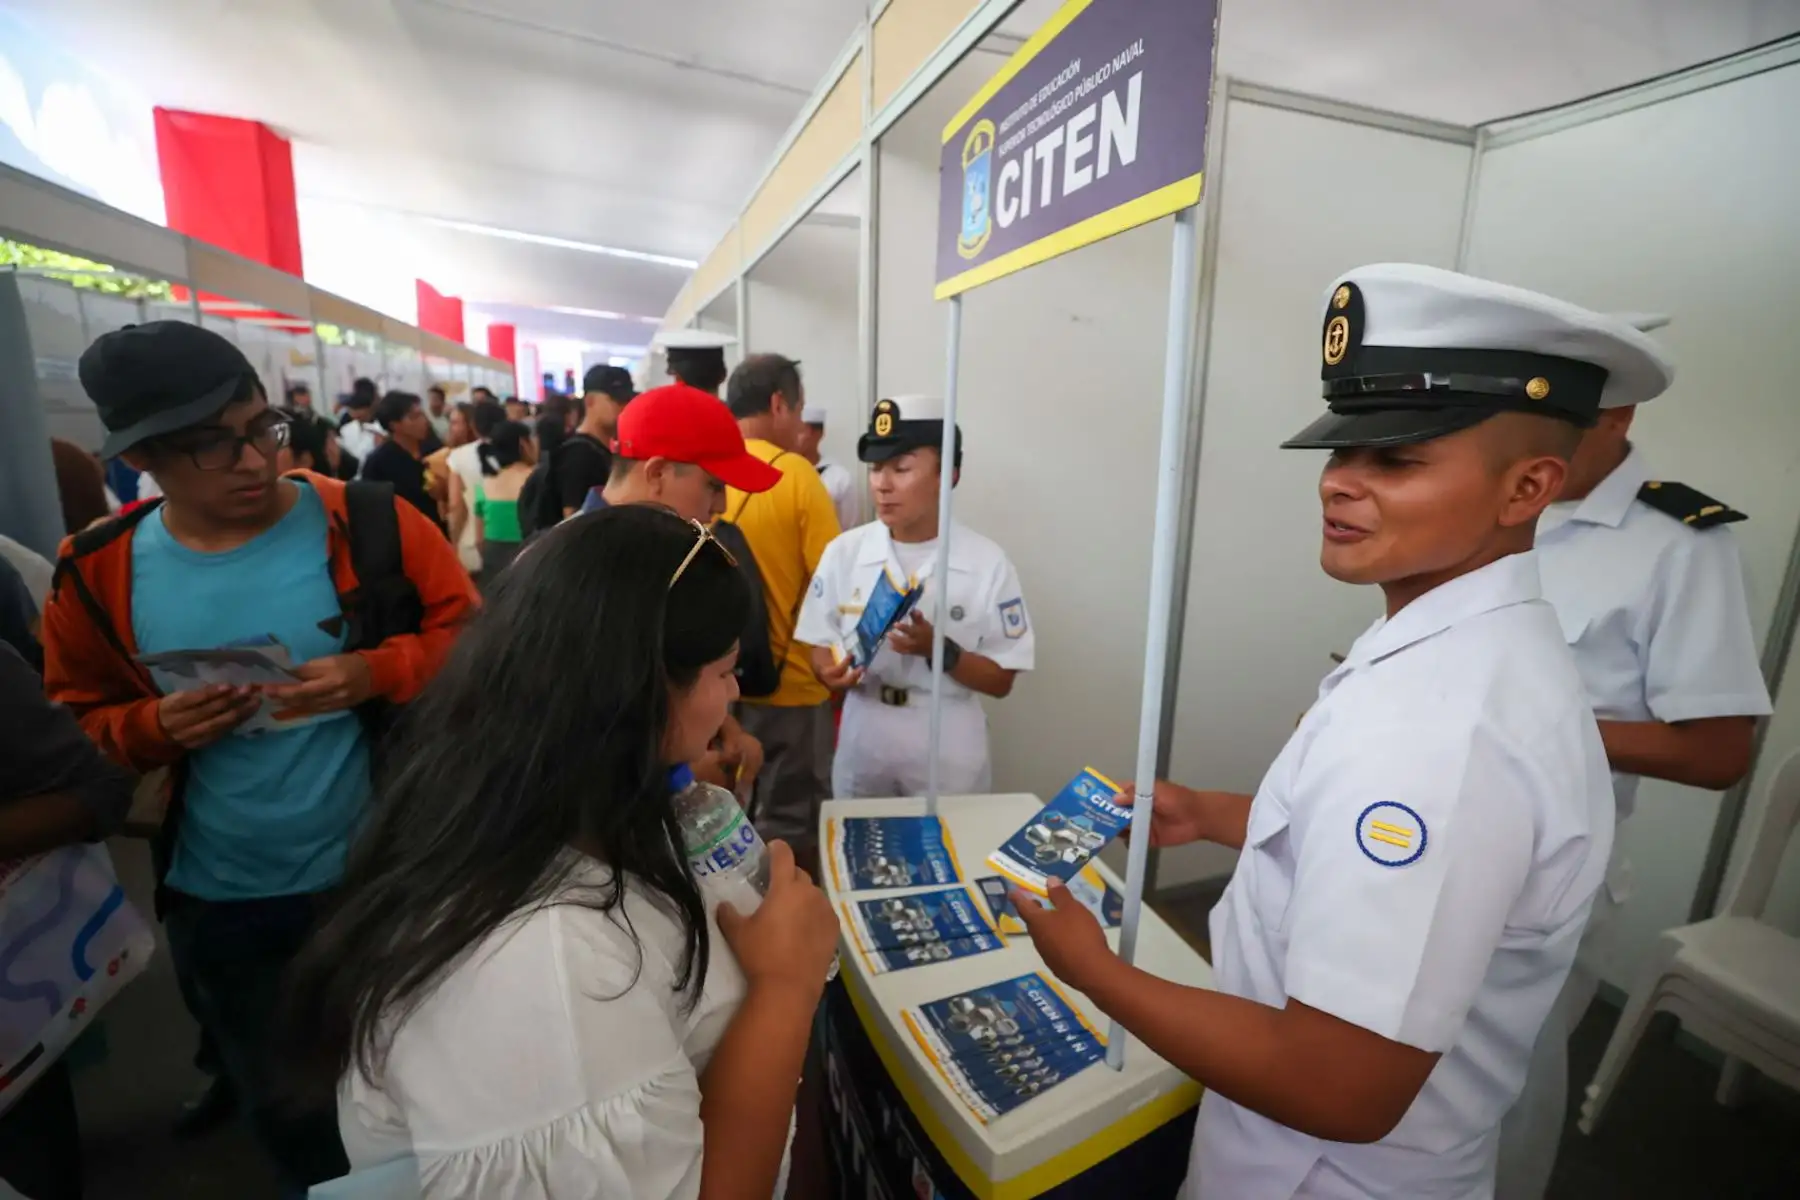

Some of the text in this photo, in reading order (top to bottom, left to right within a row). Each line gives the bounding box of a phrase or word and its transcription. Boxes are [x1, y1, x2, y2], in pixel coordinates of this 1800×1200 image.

[1038, 57, 1081, 104] EDUCACIÓN
[1074, 63, 1111, 103] PÚBLICO
[1112, 38, 1144, 75] NAVAL
[996, 71, 1143, 228] CITEN
[1089, 793, 1133, 820] CITEN
[692, 824, 755, 878] CIELO
